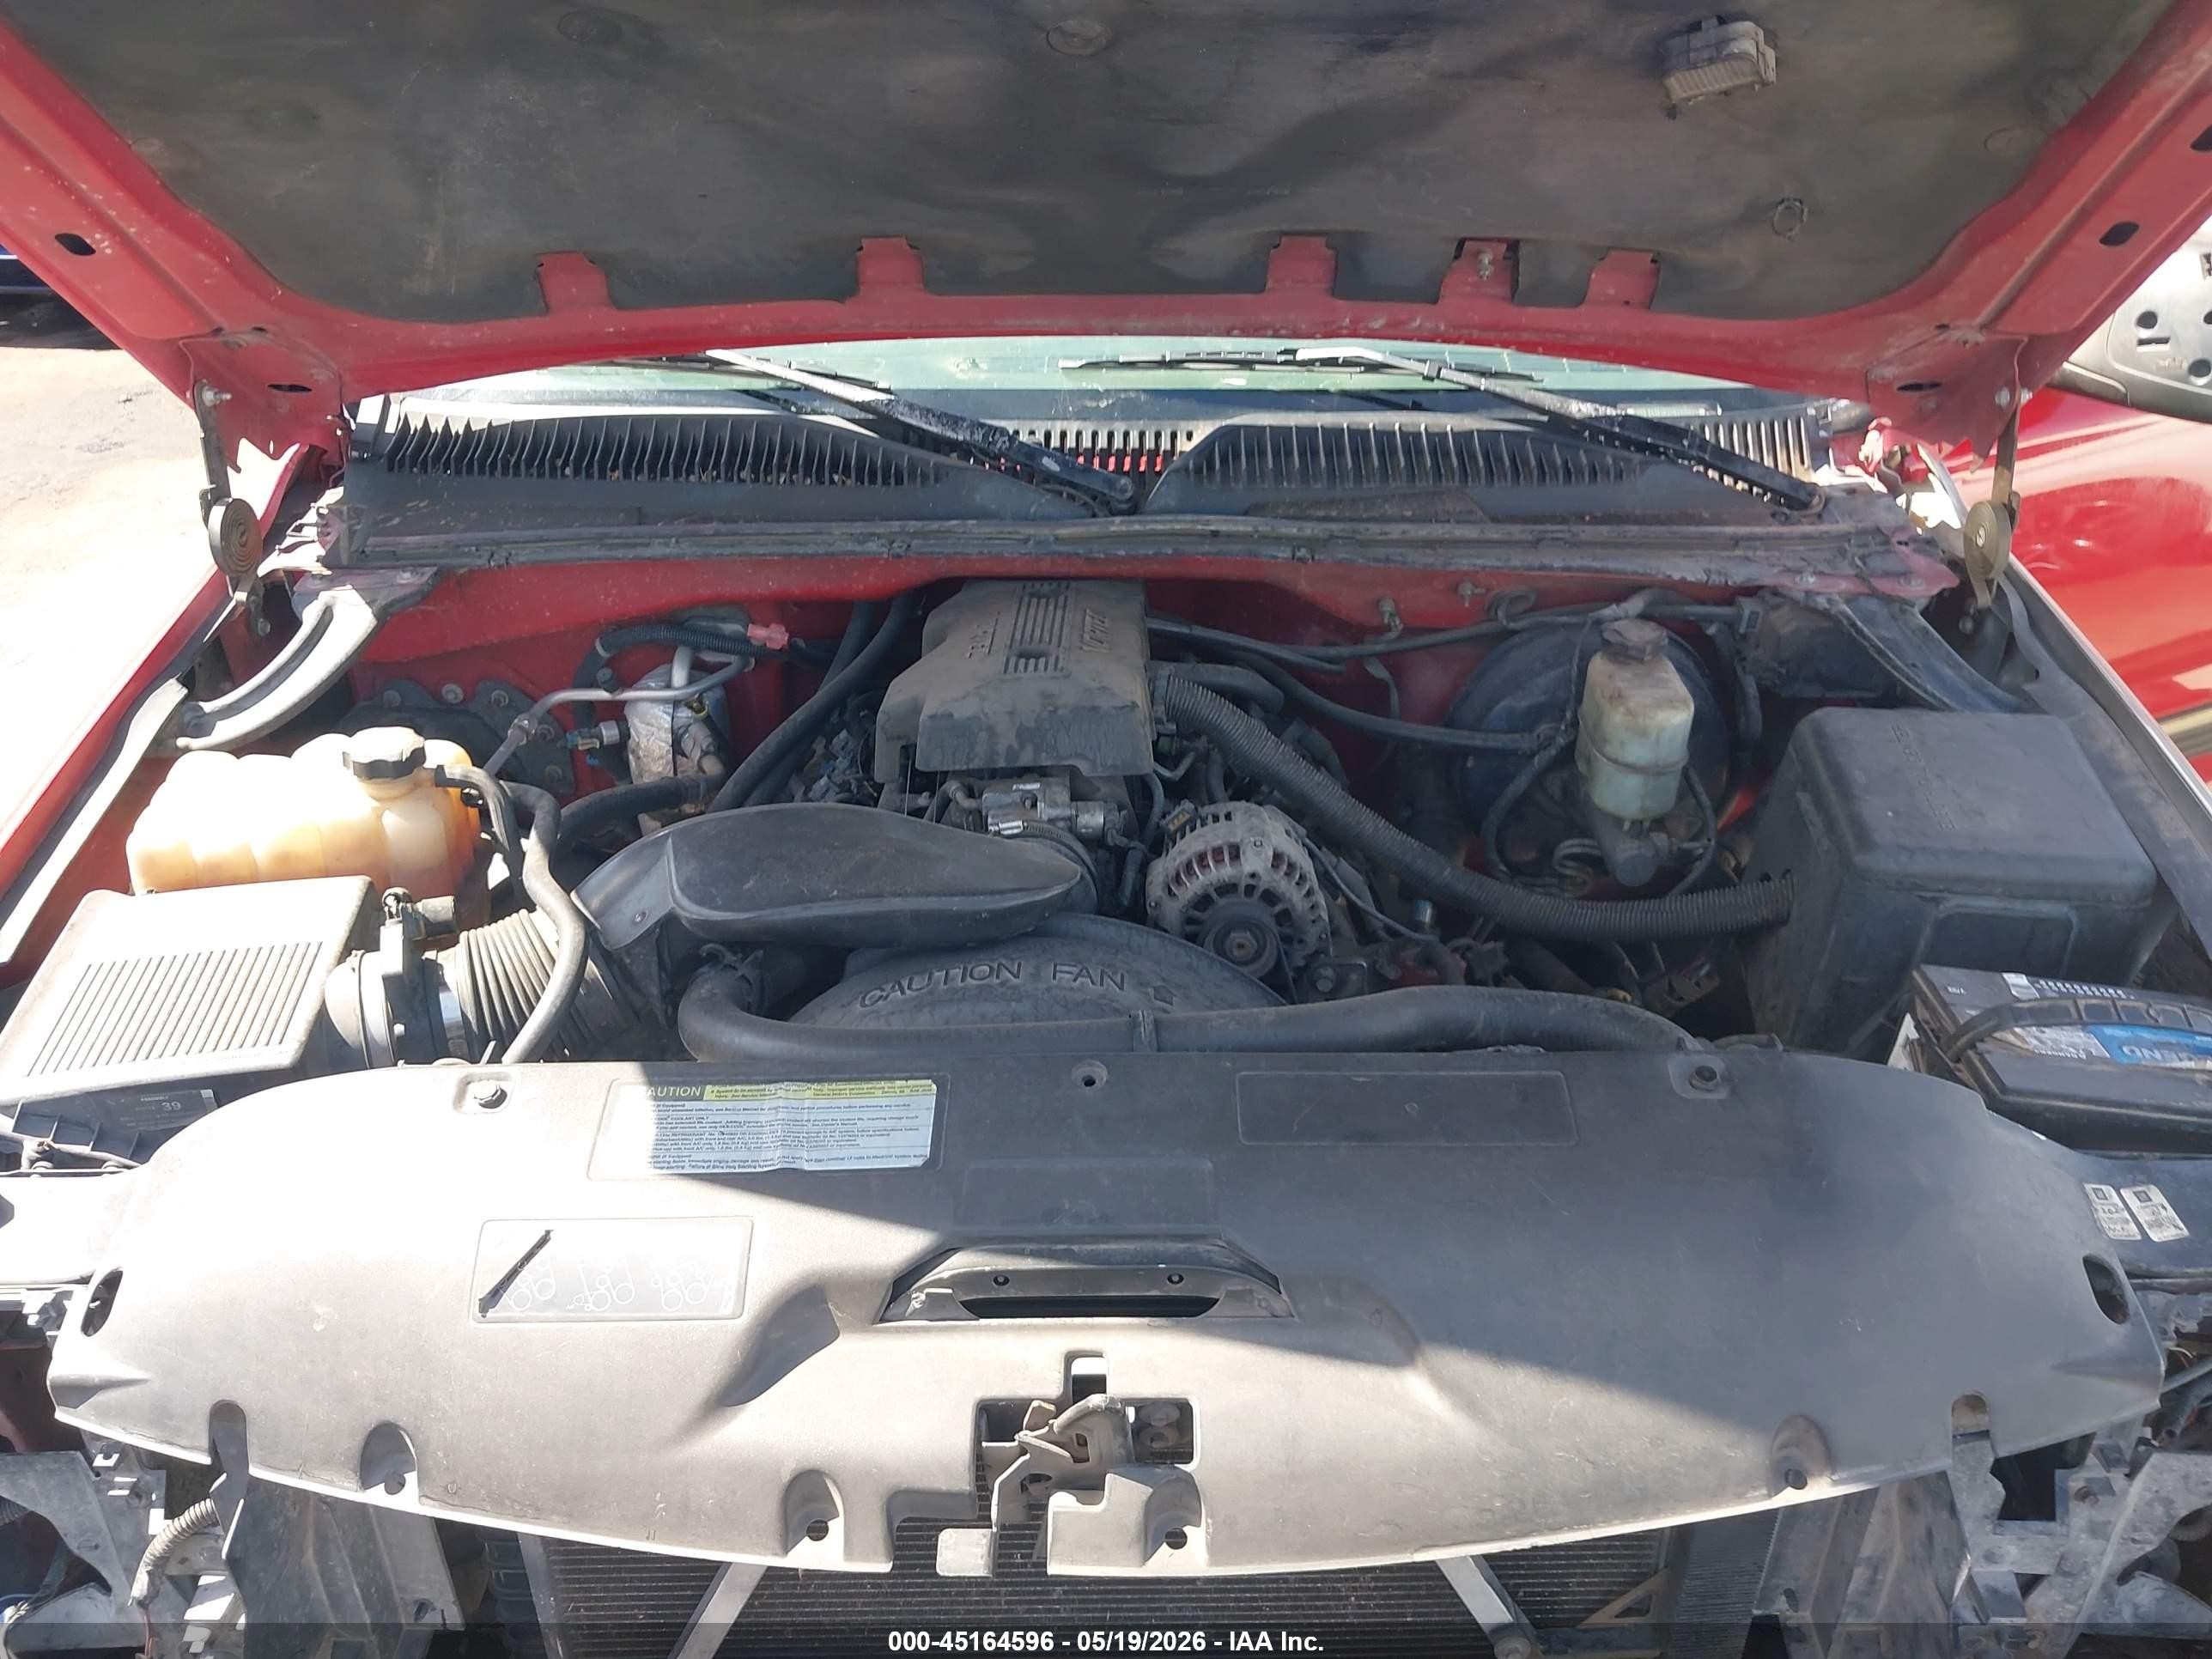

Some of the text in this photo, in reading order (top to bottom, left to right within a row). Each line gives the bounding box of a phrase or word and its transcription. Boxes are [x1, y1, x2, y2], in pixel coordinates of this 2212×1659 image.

[859, 960, 1125, 1009] CAUTION FAN
[647, 1086, 702, 1097] AUTION
[161, 1101, 182, 1111] 39
